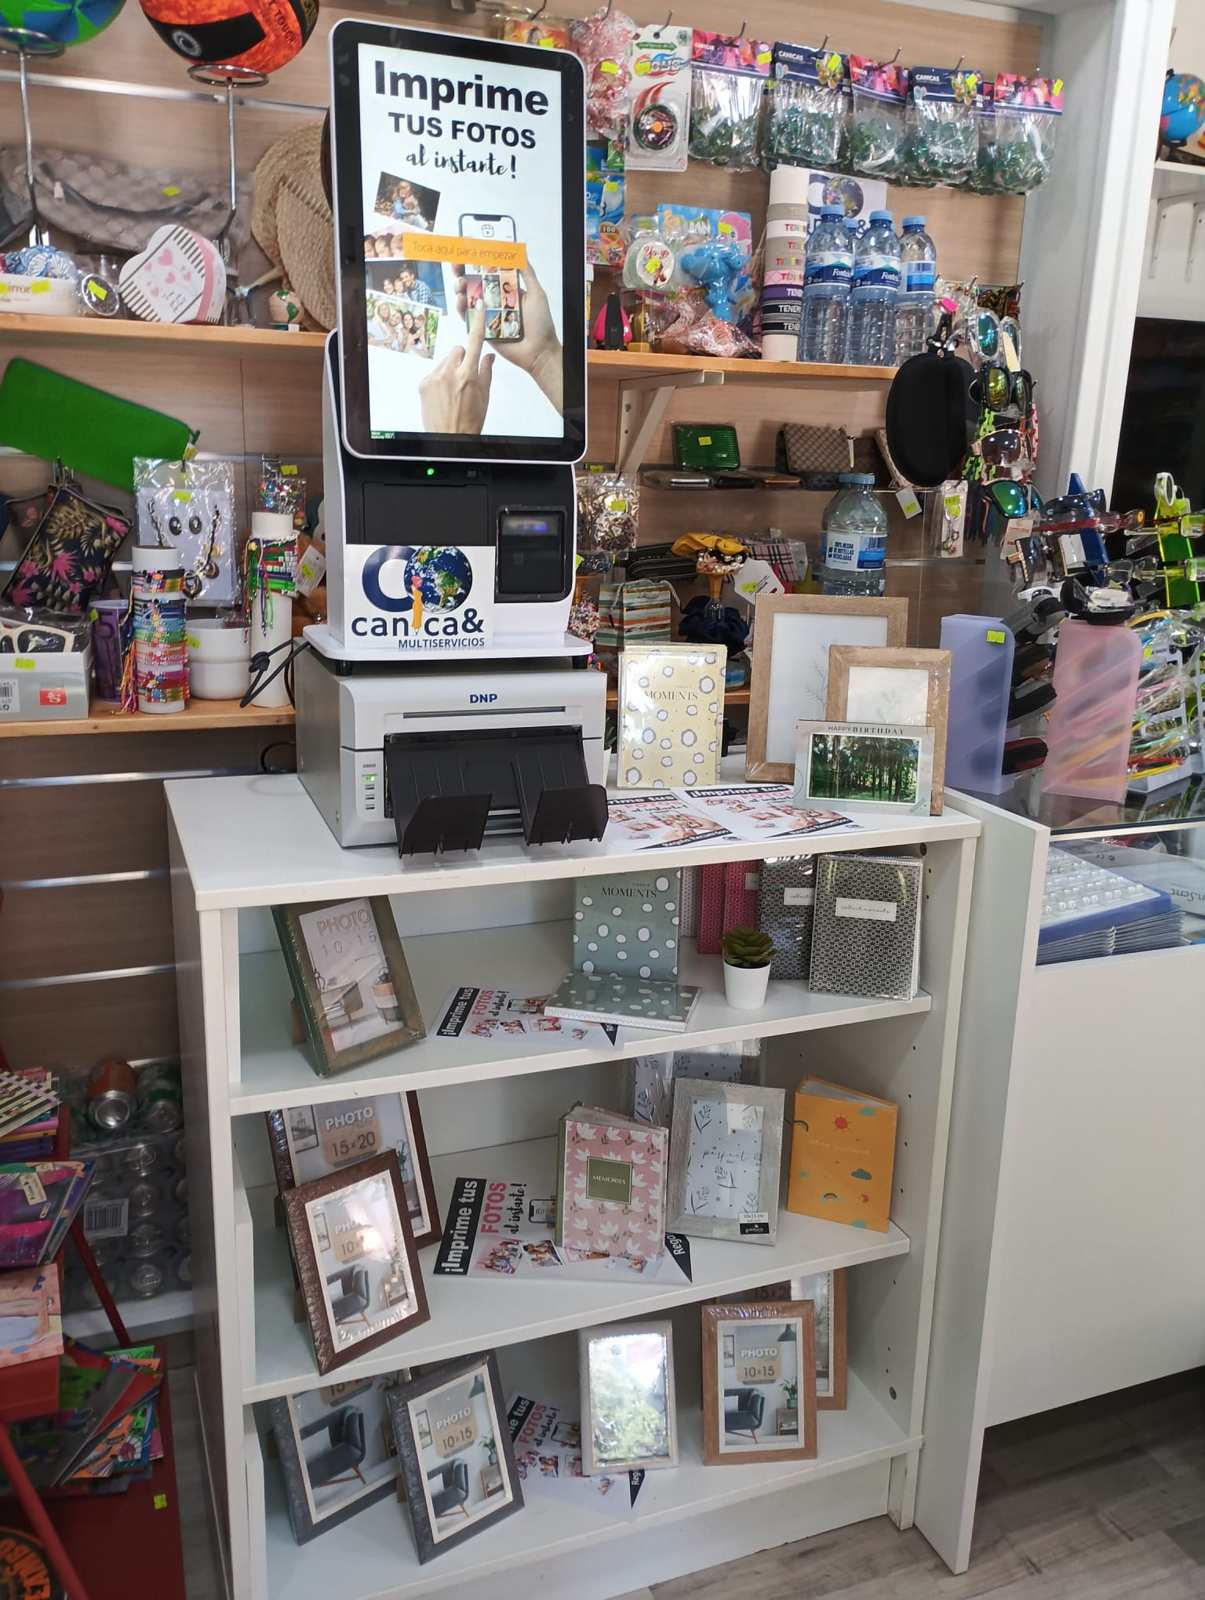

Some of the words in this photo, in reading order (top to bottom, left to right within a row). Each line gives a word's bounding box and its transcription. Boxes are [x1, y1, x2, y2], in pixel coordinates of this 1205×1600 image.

[375, 60, 549, 116] Imprime
[388, 112, 443, 138] TUS
[451, 120, 537, 150] FOTOS
[406, 143, 429, 167] al
[398, 637, 485, 649] MULTISERVICIOS
[469, 693, 498, 704] DNP
[601, 887, 657, 898] MOMENTS
[471, 990, 495, 1015] FOTOS
[325, 1106, 374, 1130] PHOTO
[458, 1180, 478, 1203] tus
[480, 1182, 507, 1233] FOTOS
[740, 1347, 778, 1359] PHOTO
[435, 1406, 472, 1431] PHOTO
[519, 1402, 546, 1444] FOTOS
